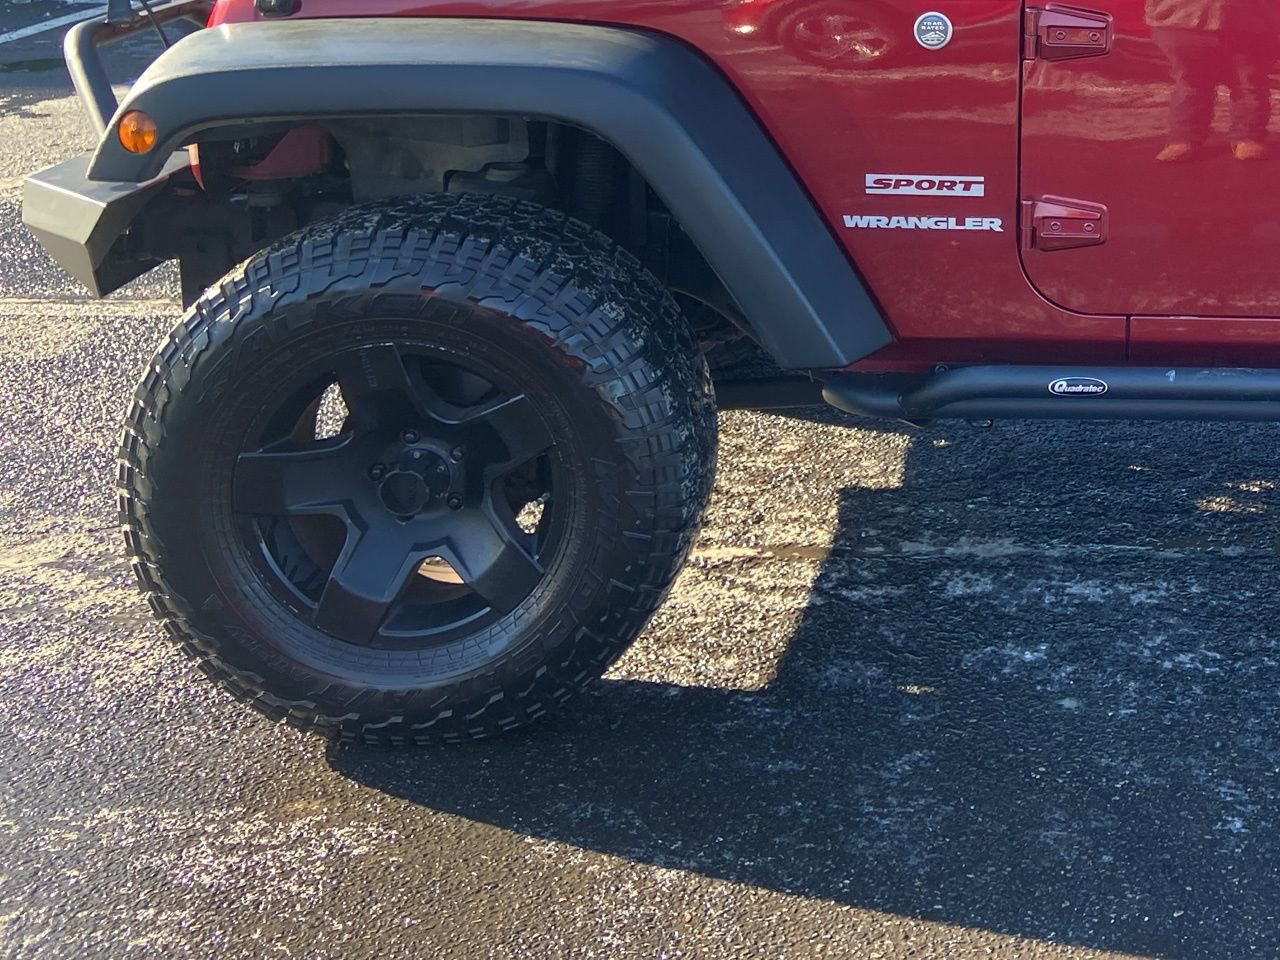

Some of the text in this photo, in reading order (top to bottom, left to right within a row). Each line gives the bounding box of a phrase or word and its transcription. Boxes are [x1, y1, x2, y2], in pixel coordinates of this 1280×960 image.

[866, 177, 984, 193] SPORT
[843, 215, 1004, 232] WRANGLER
[1054, 381, 1104, 393] Quadratec
